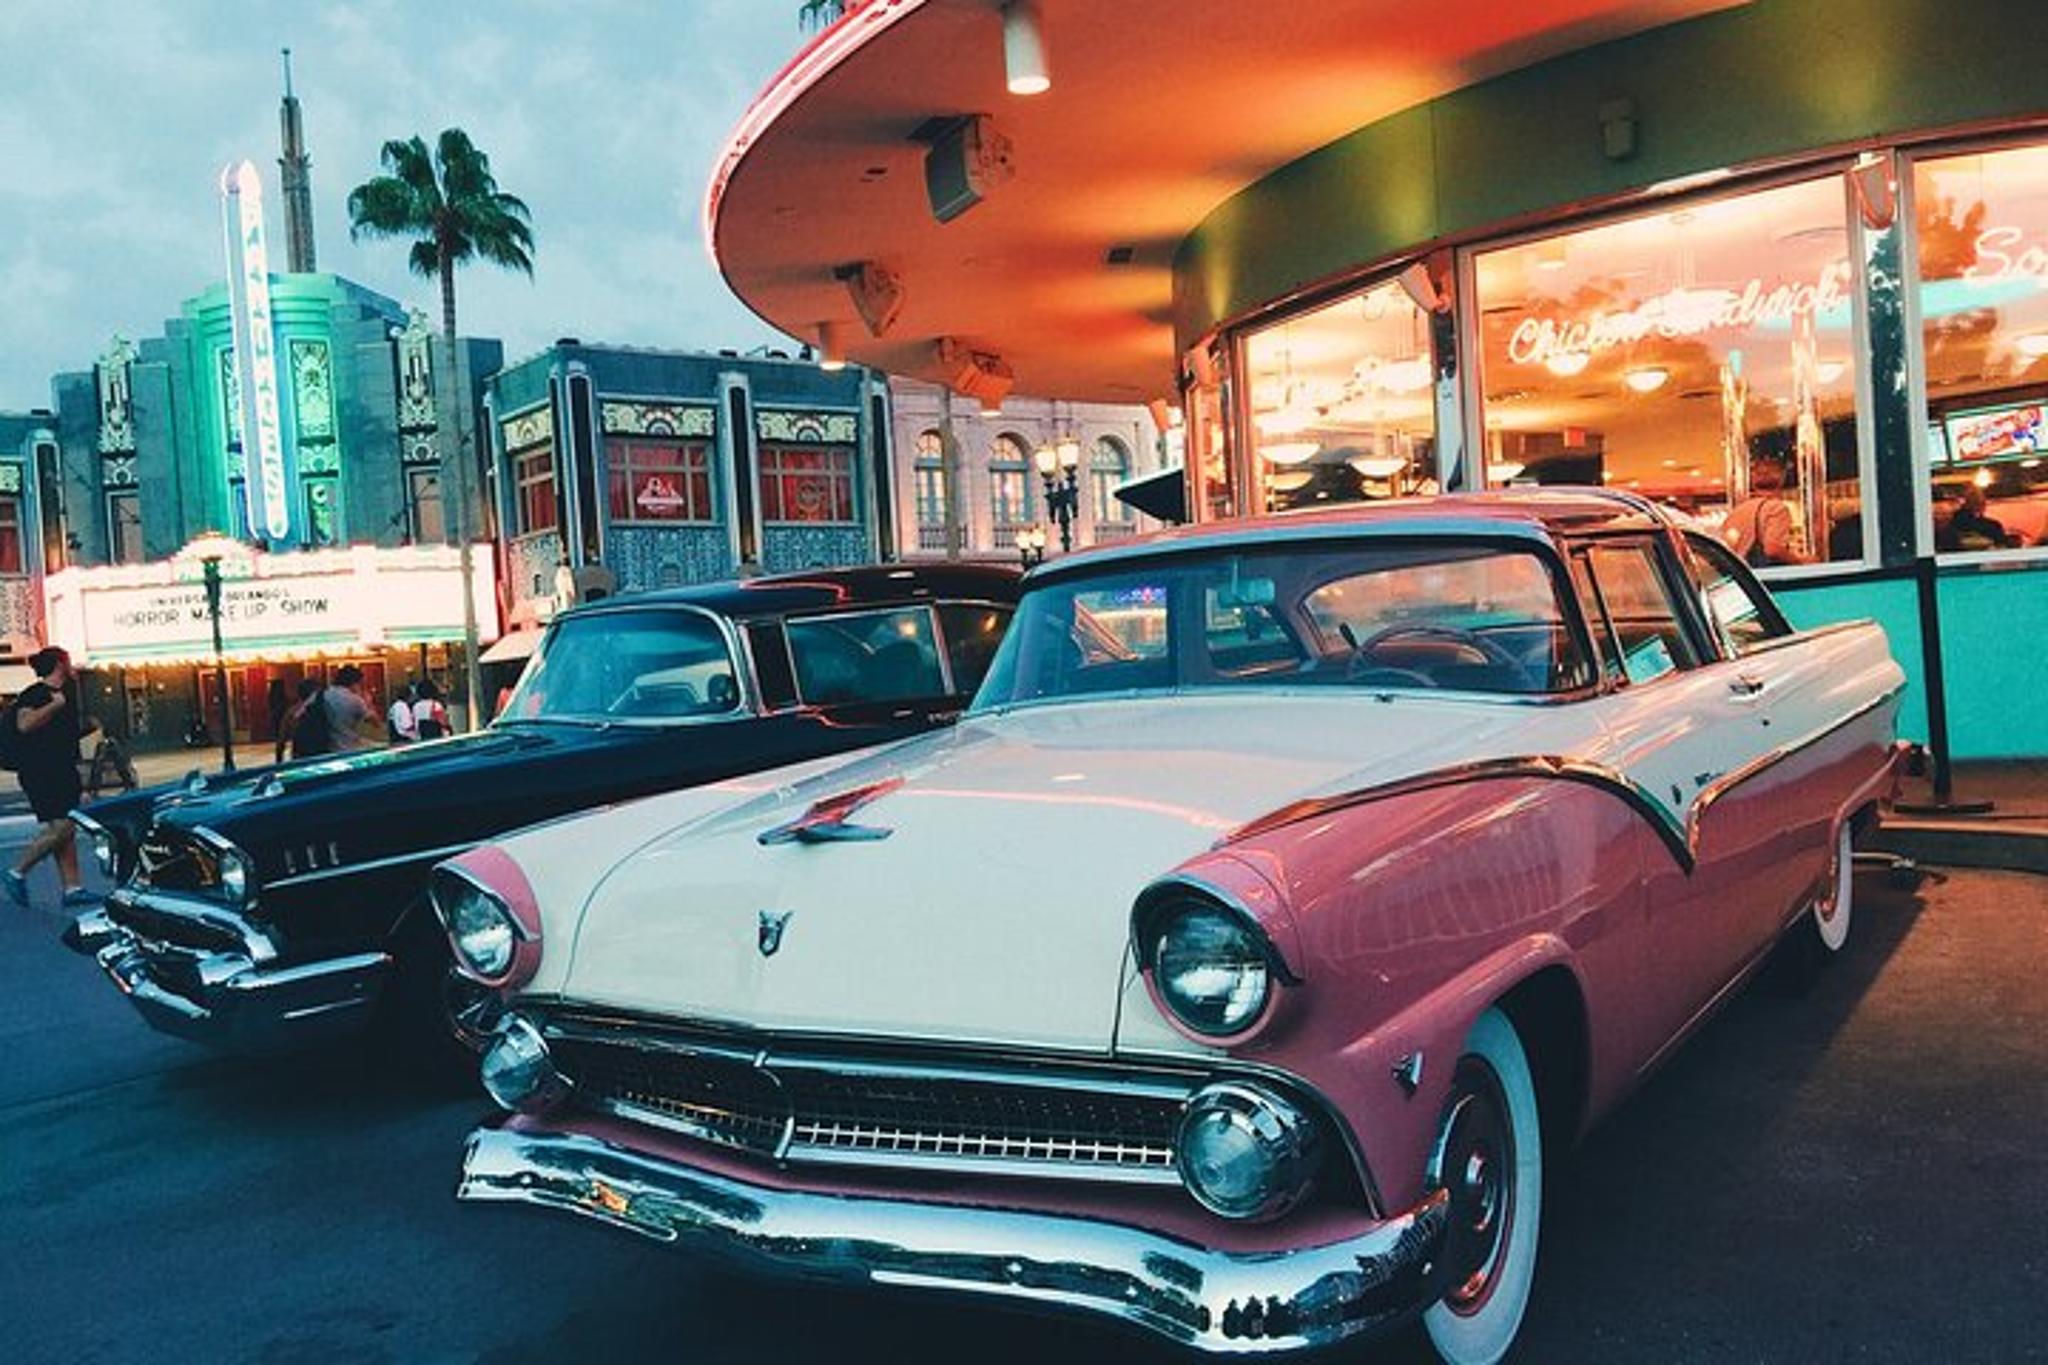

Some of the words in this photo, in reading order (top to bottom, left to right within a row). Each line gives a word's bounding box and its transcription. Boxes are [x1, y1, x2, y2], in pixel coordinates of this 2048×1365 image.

[1508, 311, 1654, 364] Chicken
[114, 609, 180, 628] HORROR
[281, 598, 329, 614] SHOW
